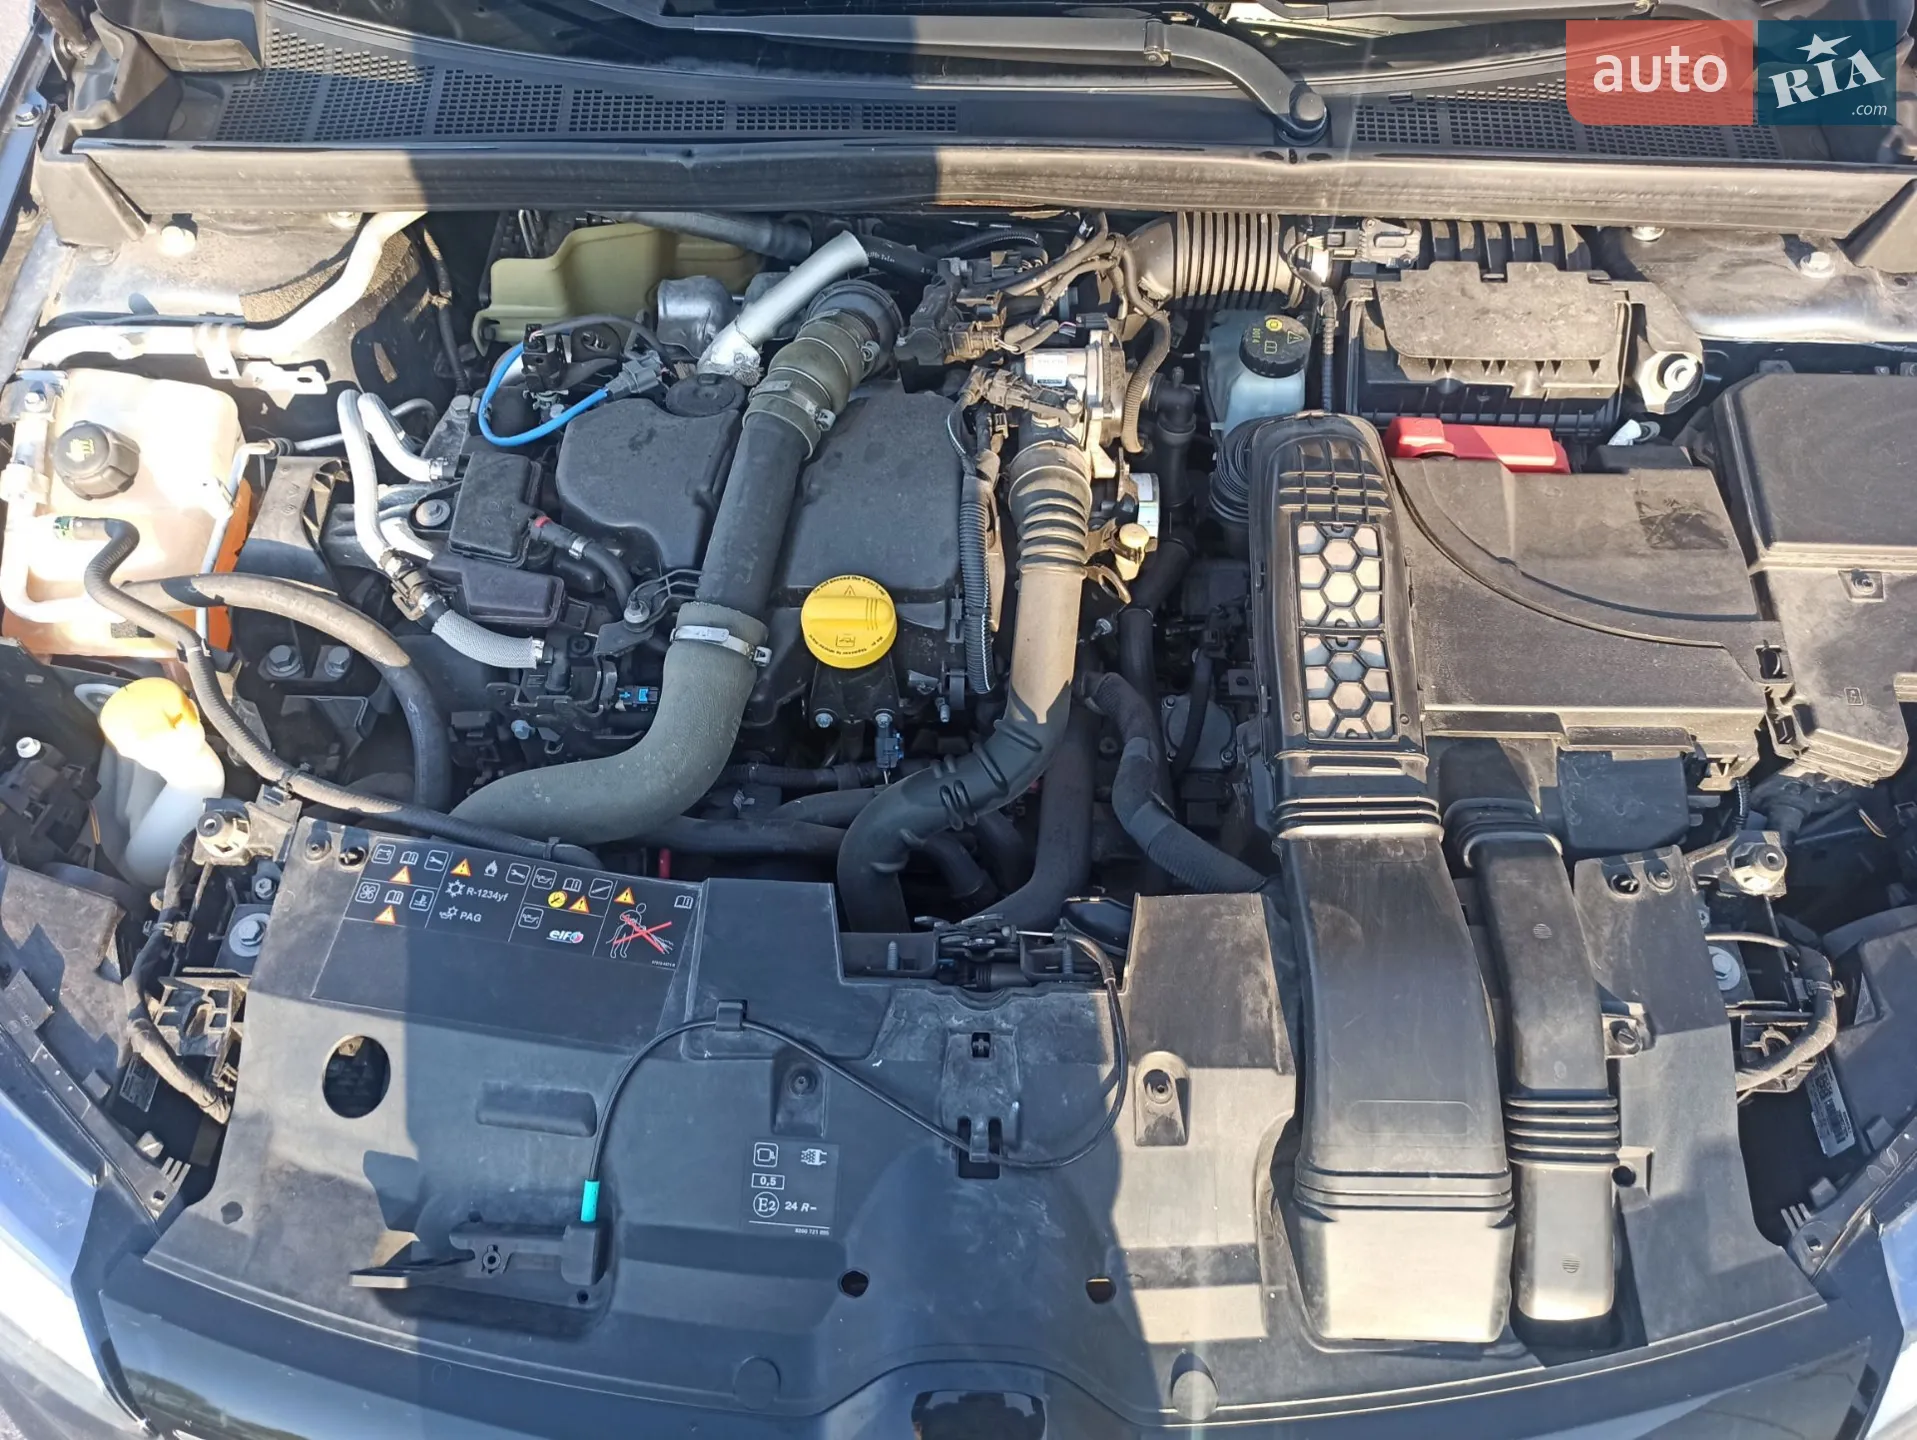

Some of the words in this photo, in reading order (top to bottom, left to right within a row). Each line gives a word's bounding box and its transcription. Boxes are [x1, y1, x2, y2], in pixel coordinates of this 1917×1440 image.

[465, 886, 509, 902] R-1234yf
[459, 911, 482, 923] PAG
[759, 1176, 777, 1186] 0,5
[757, 1197, 777, 1213] E2
[784, 1201, 798, 1211] 24
